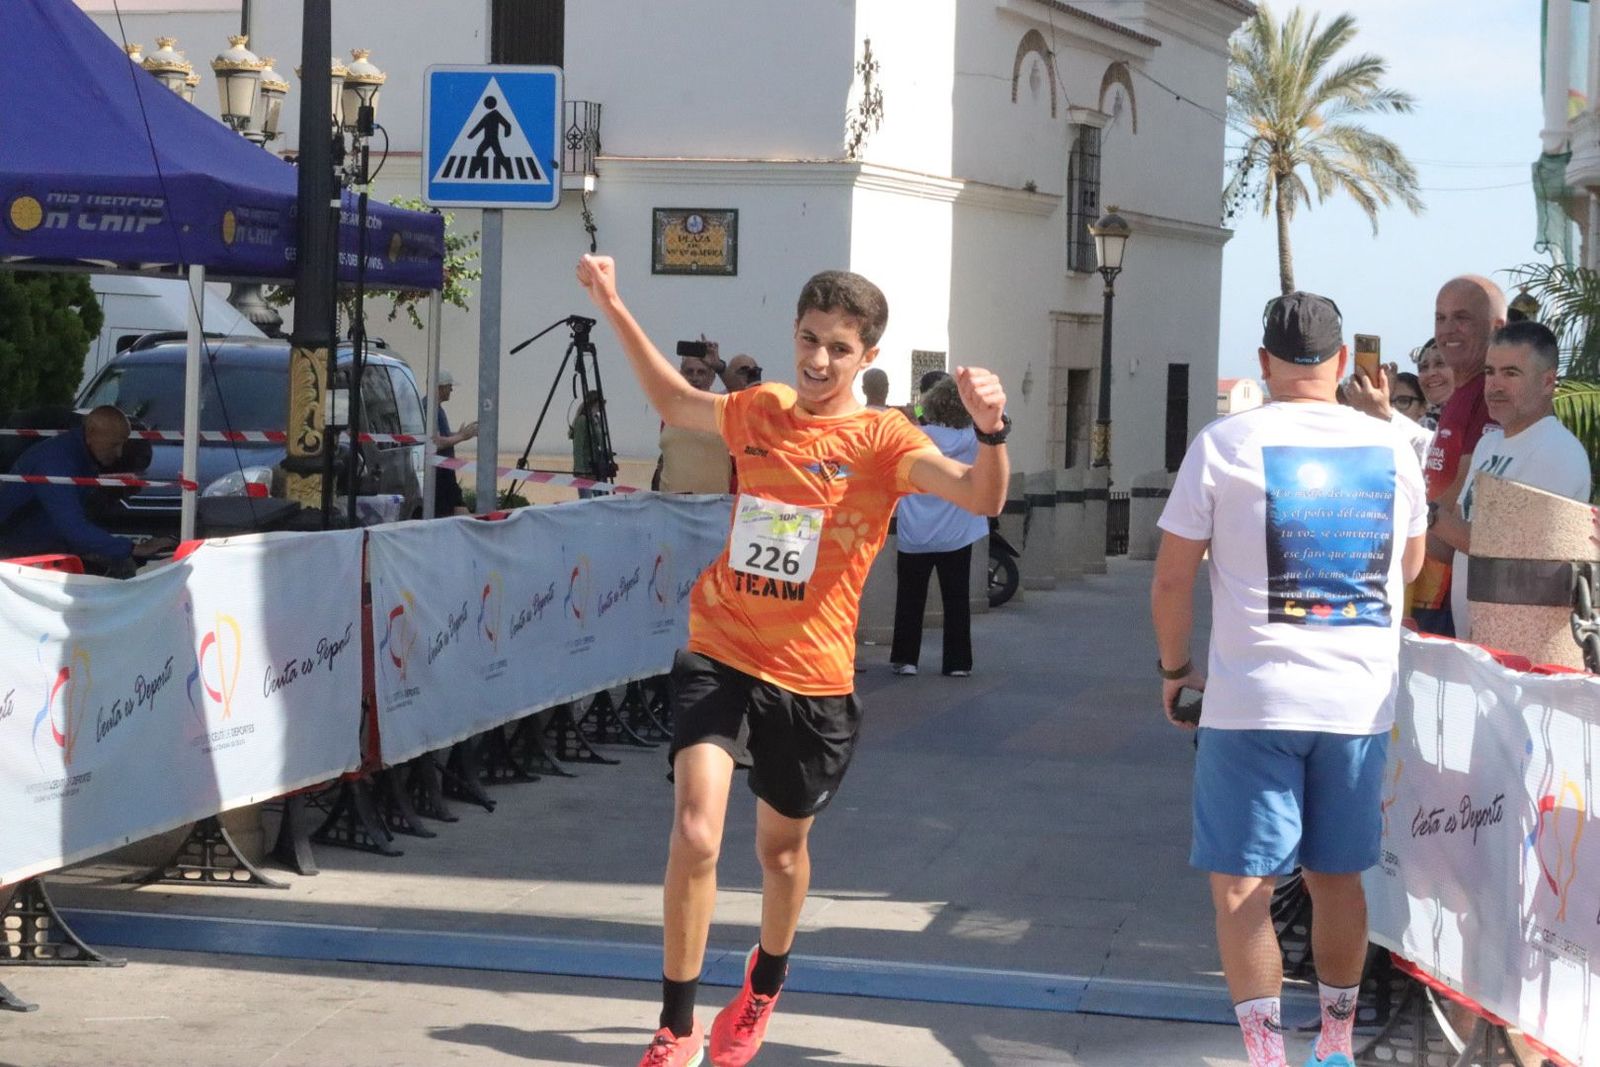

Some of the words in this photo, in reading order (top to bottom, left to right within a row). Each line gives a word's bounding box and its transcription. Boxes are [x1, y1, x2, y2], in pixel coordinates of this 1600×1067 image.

[1304, 508, 1333, 521] polvo
[1337, 507, 1352, 518] del
[1281, 529, 1293, 538] tu
[1297, 530, 1316, 538] voz
[745, 542, 800, 575] 226
[1283, 550, 1299, 559] ese
[1301, 547, 1324, 561] faro
[1328, 550, 1347, 560] que
[1349, 551, 1385, 560] anuncia
[734, 570, 806, 601] TEAM
[1283, 571, 1301, 581] que
[1304, 568, 1315, 578] lo
[263, 658, 298, 698] Ceuta
[301, 658, 314, 674] es
[96, 699, 122, 743] Ceuta
[125, 698, 135, 716] es
[135, 655, 174, 711] Deporte
[1445, 813, 1457, 834] es
[1459, 793, 1505, 846] Deporte
